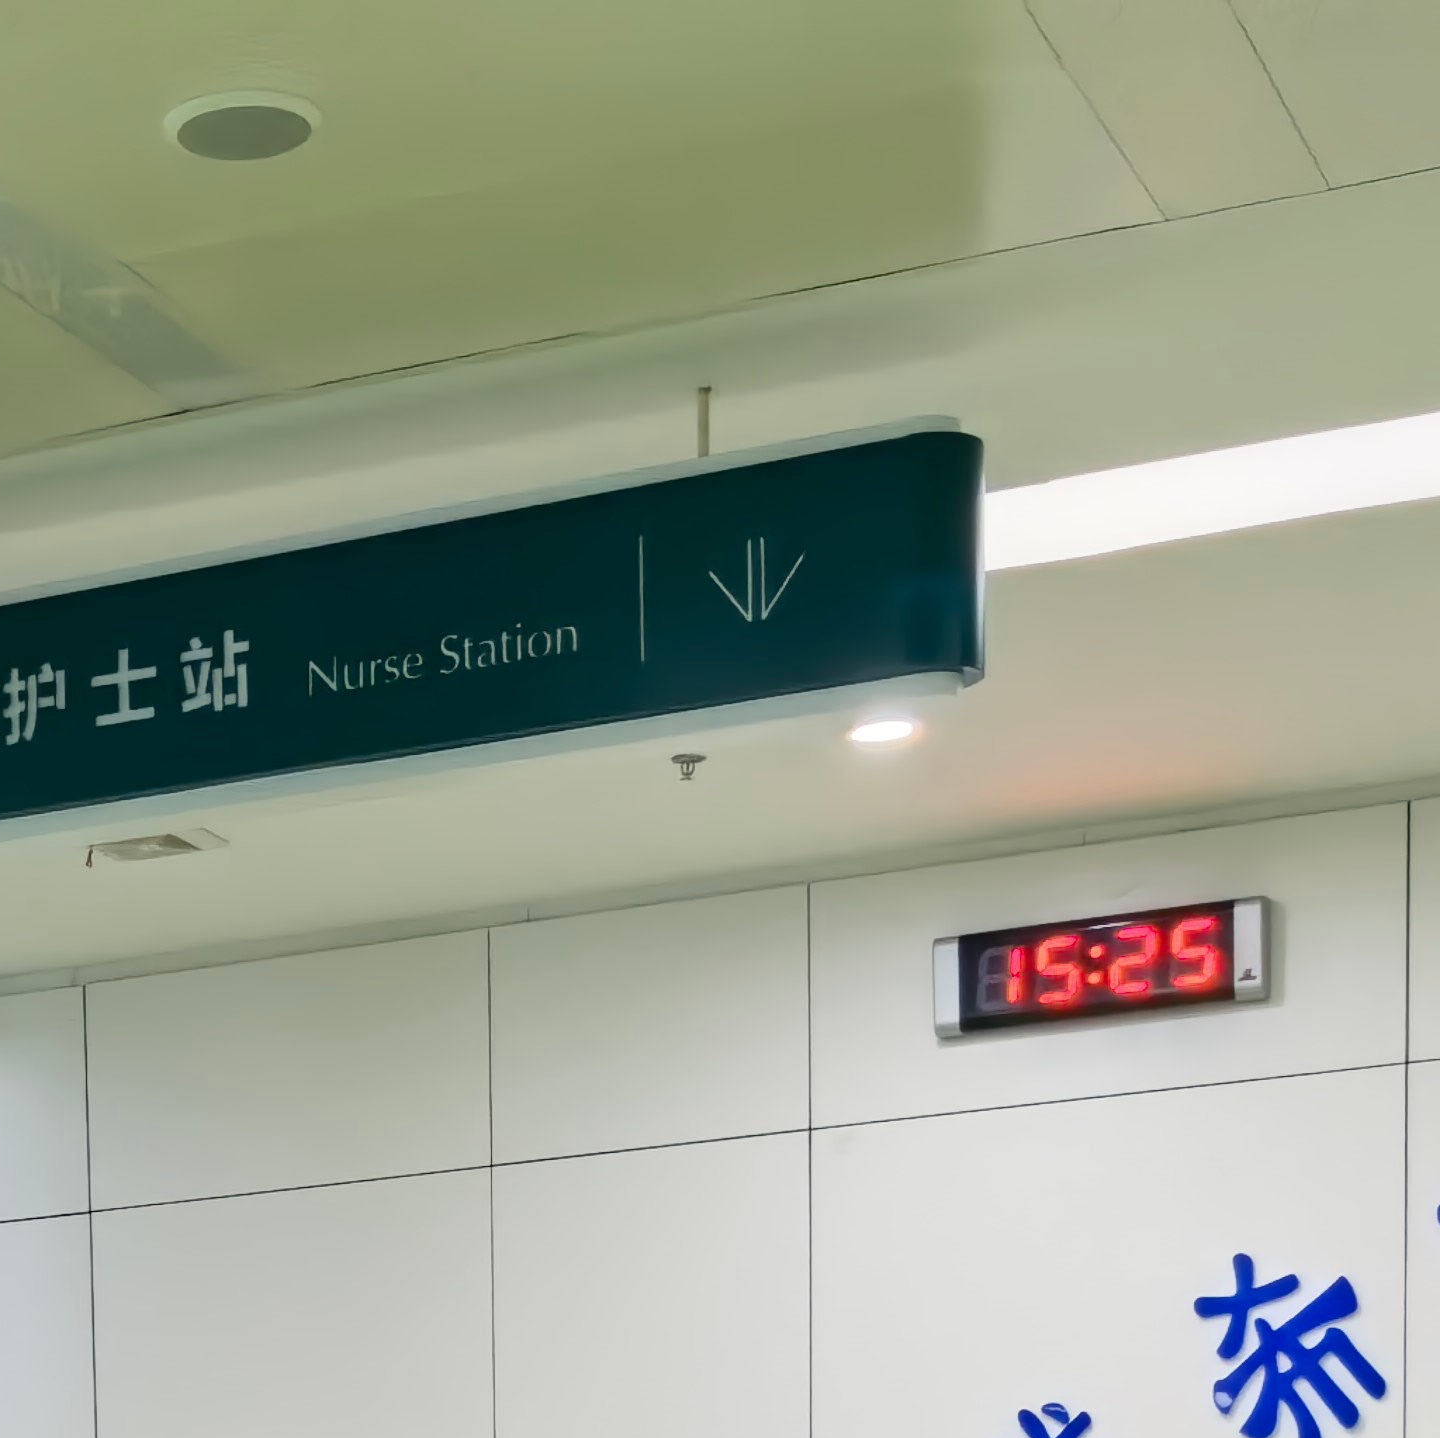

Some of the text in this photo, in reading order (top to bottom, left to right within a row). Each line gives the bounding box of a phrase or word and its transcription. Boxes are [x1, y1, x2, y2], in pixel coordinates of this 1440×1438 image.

[3, 630, 250, 745] 护士站
[307, 622, 579, 697] Nurse Station
[1006, 916, 1218, 1006] 15:25
